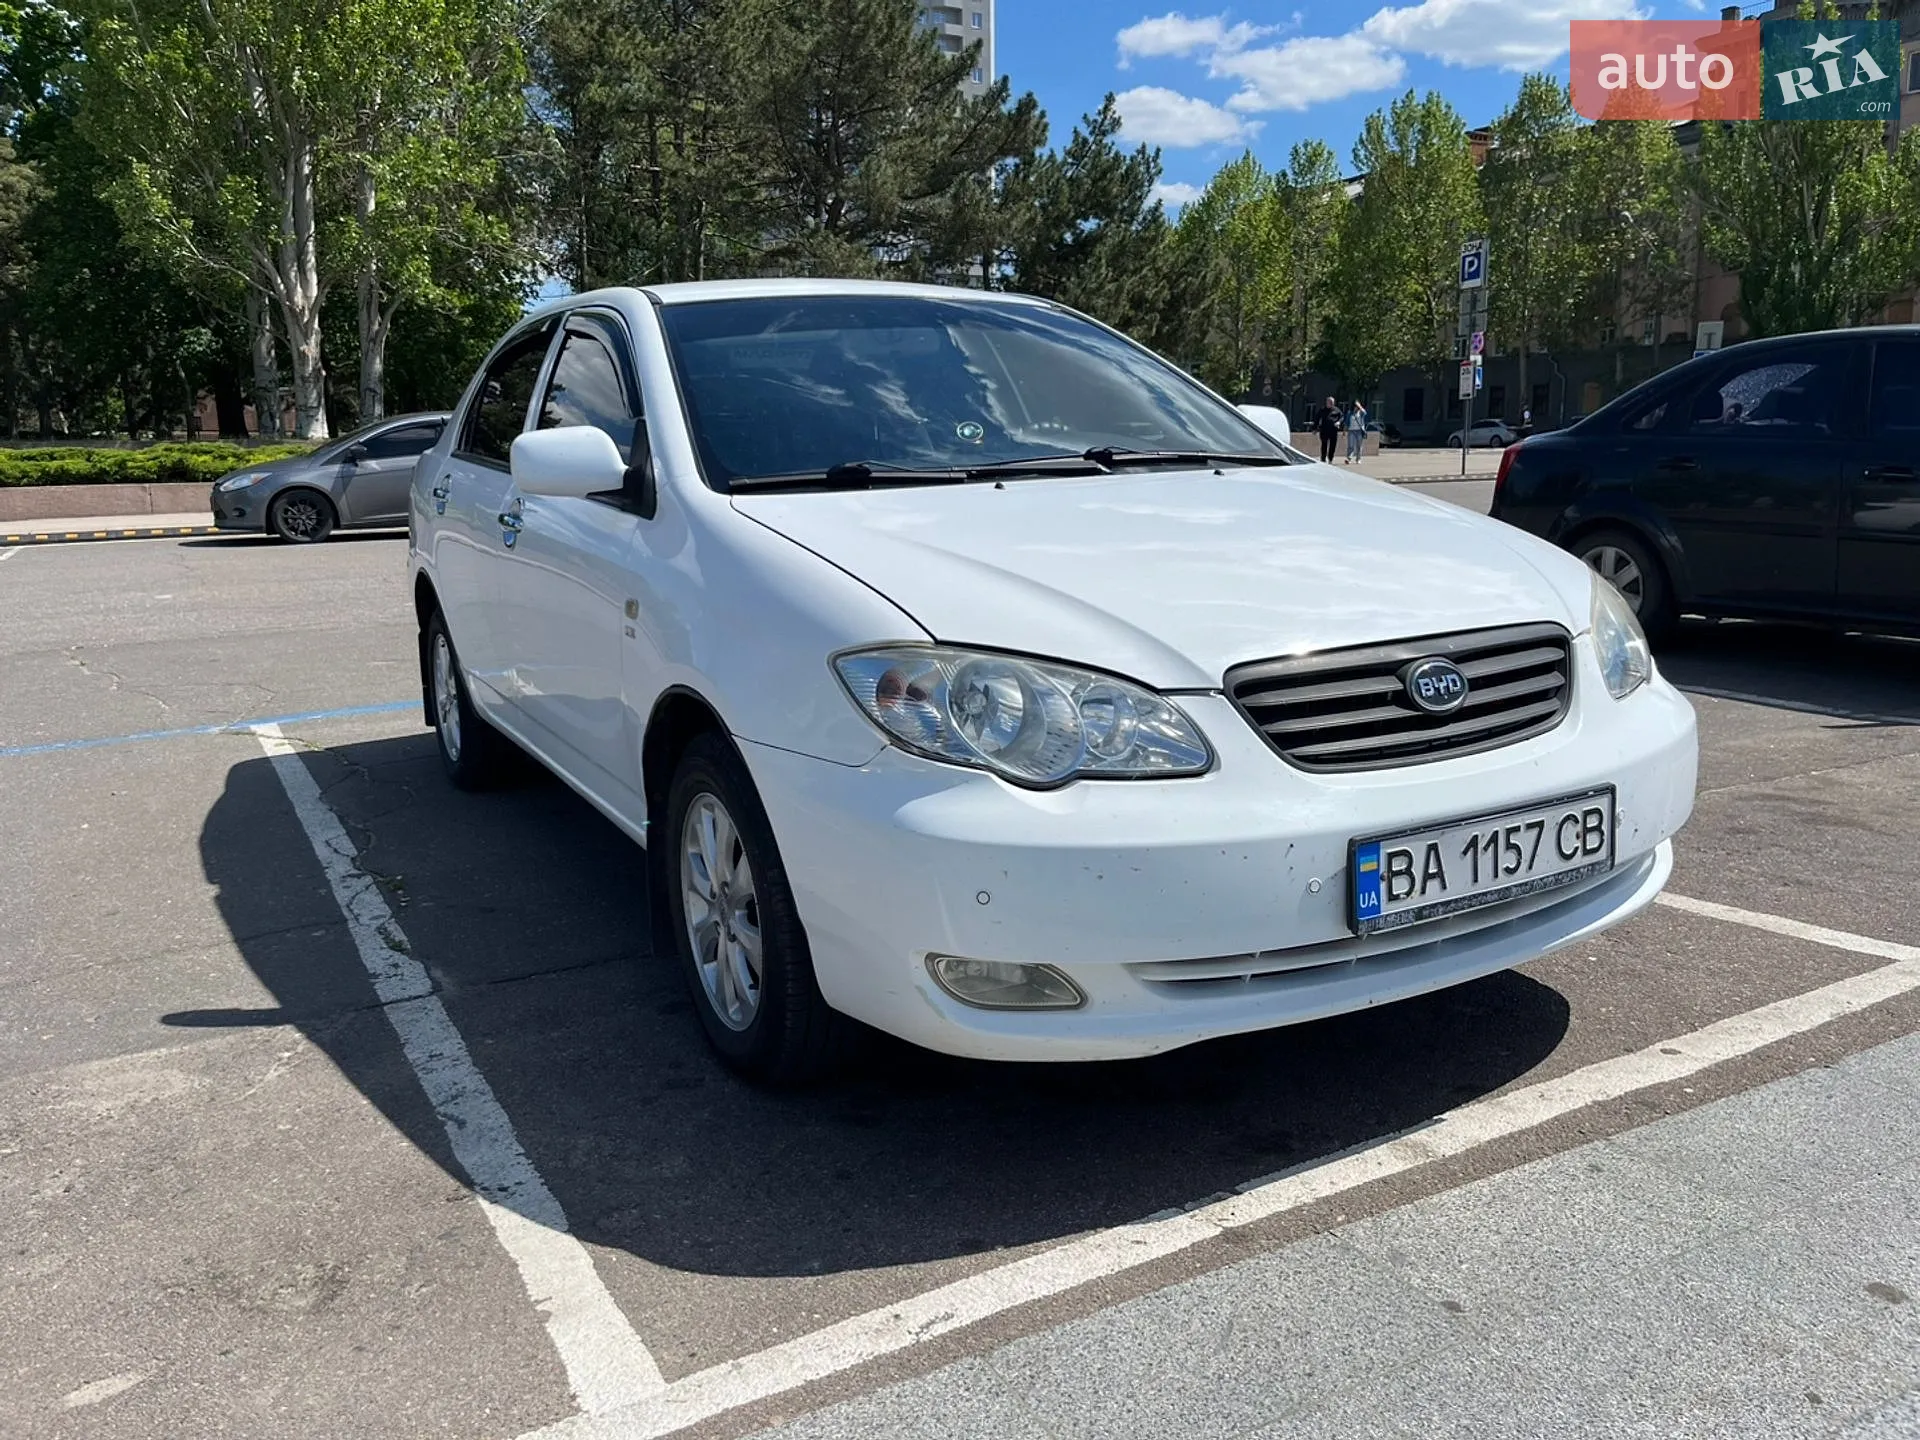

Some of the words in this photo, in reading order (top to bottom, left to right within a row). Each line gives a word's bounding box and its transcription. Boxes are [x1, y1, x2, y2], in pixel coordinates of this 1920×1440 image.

[1464, 255, 1479, 279] P
[1418, 673, 1462, 697] BYD
[1385, 841, 1448, 902] BA
[1461, 818, 1546, 884] 1157
[1556, 806, 1606, 862] CB
[1359, 890, 1379, 910] UA
